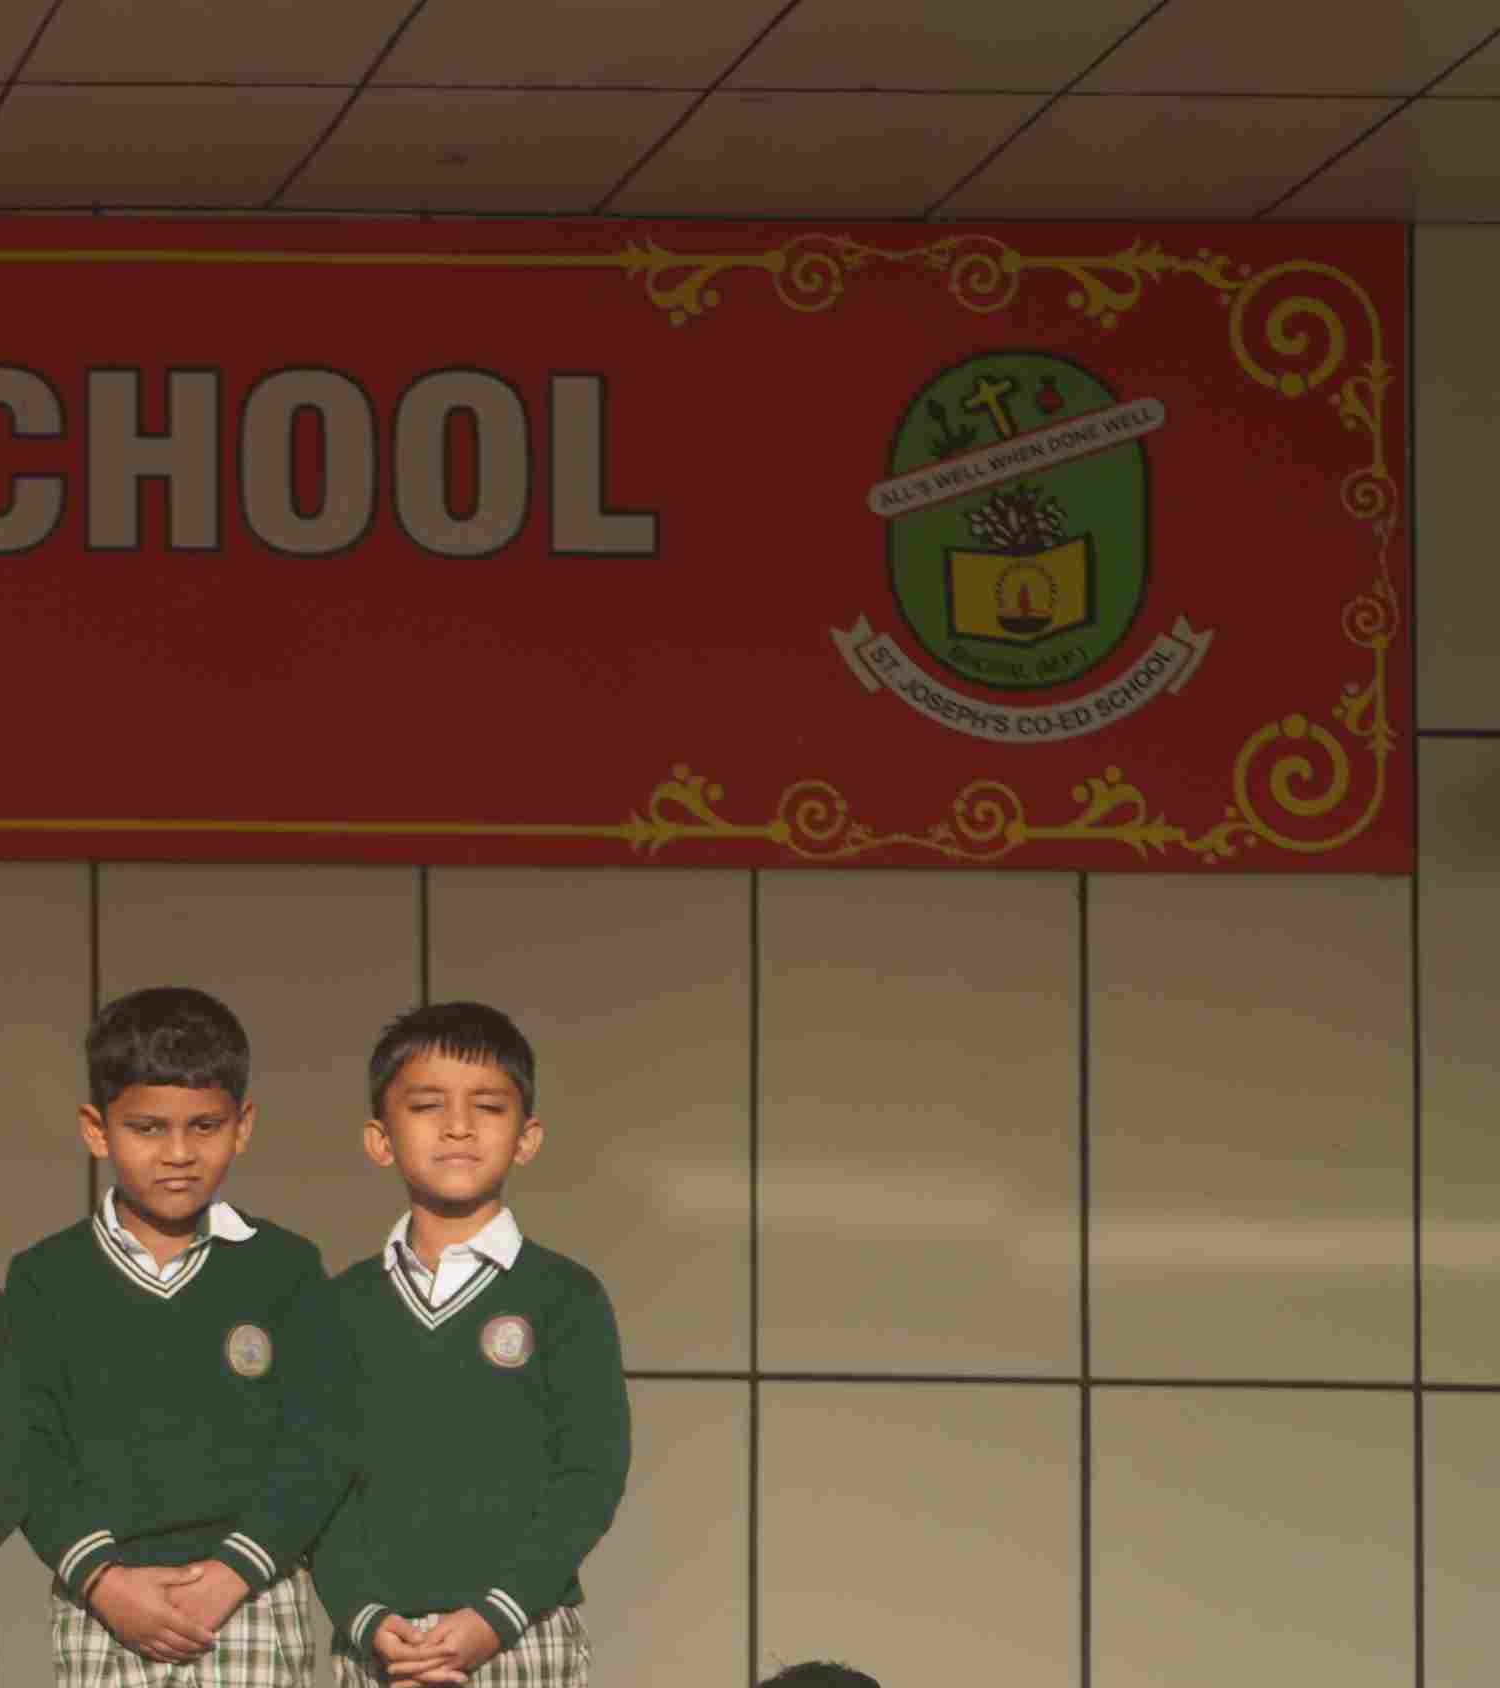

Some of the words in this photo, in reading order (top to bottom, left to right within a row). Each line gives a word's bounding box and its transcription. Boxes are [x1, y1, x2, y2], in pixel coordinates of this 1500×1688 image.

[933, 462, 987, 491] WELL
[987, 443, 1046, 472] WHEN
[1101, 405, 1153, 434] WELL
[1017, 705, 1093, 736] CO-ED
[1094, 647, 1175, 718] SCHOOL
